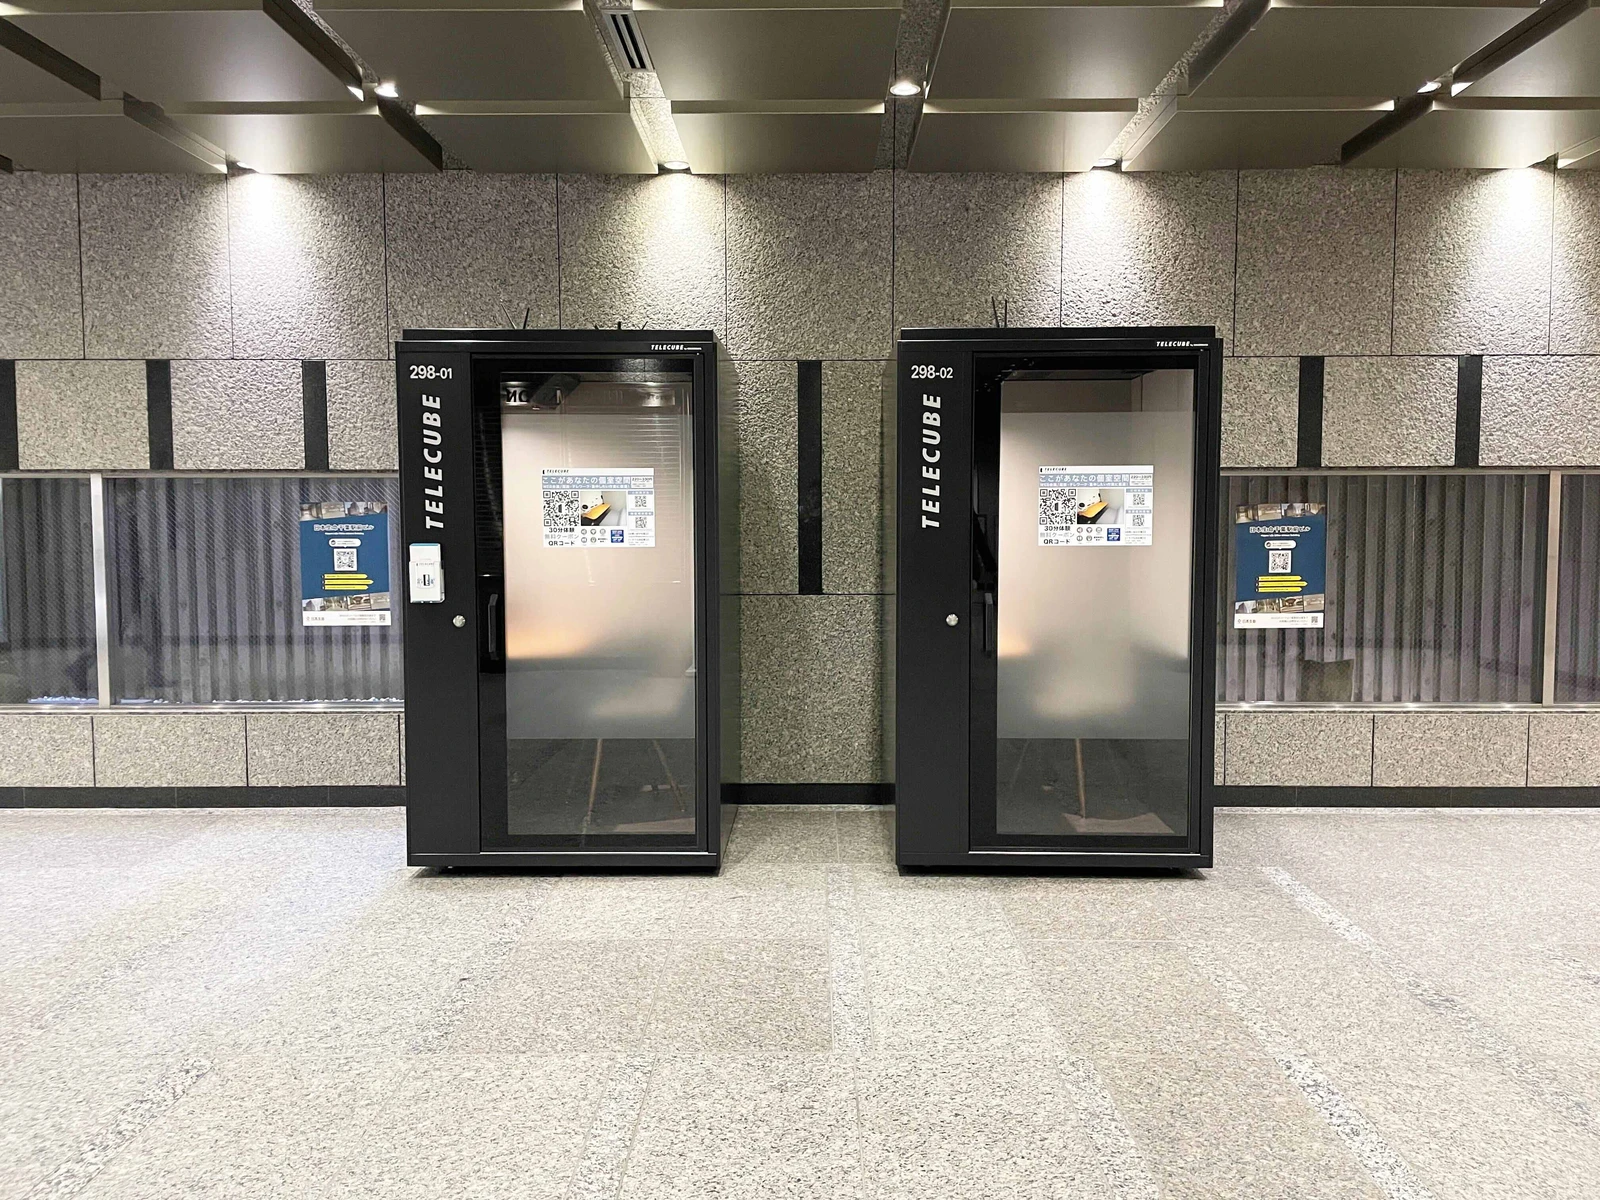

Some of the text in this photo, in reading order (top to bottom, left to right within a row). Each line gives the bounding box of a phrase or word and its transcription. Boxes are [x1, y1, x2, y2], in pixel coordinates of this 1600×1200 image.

[409, 365, 453, 379] 298-01
[910, 365, 954, 379] 298-02
[422, 394, 444, 529] TELECUBE
[921, 394, 941, 528] TELECUBE
